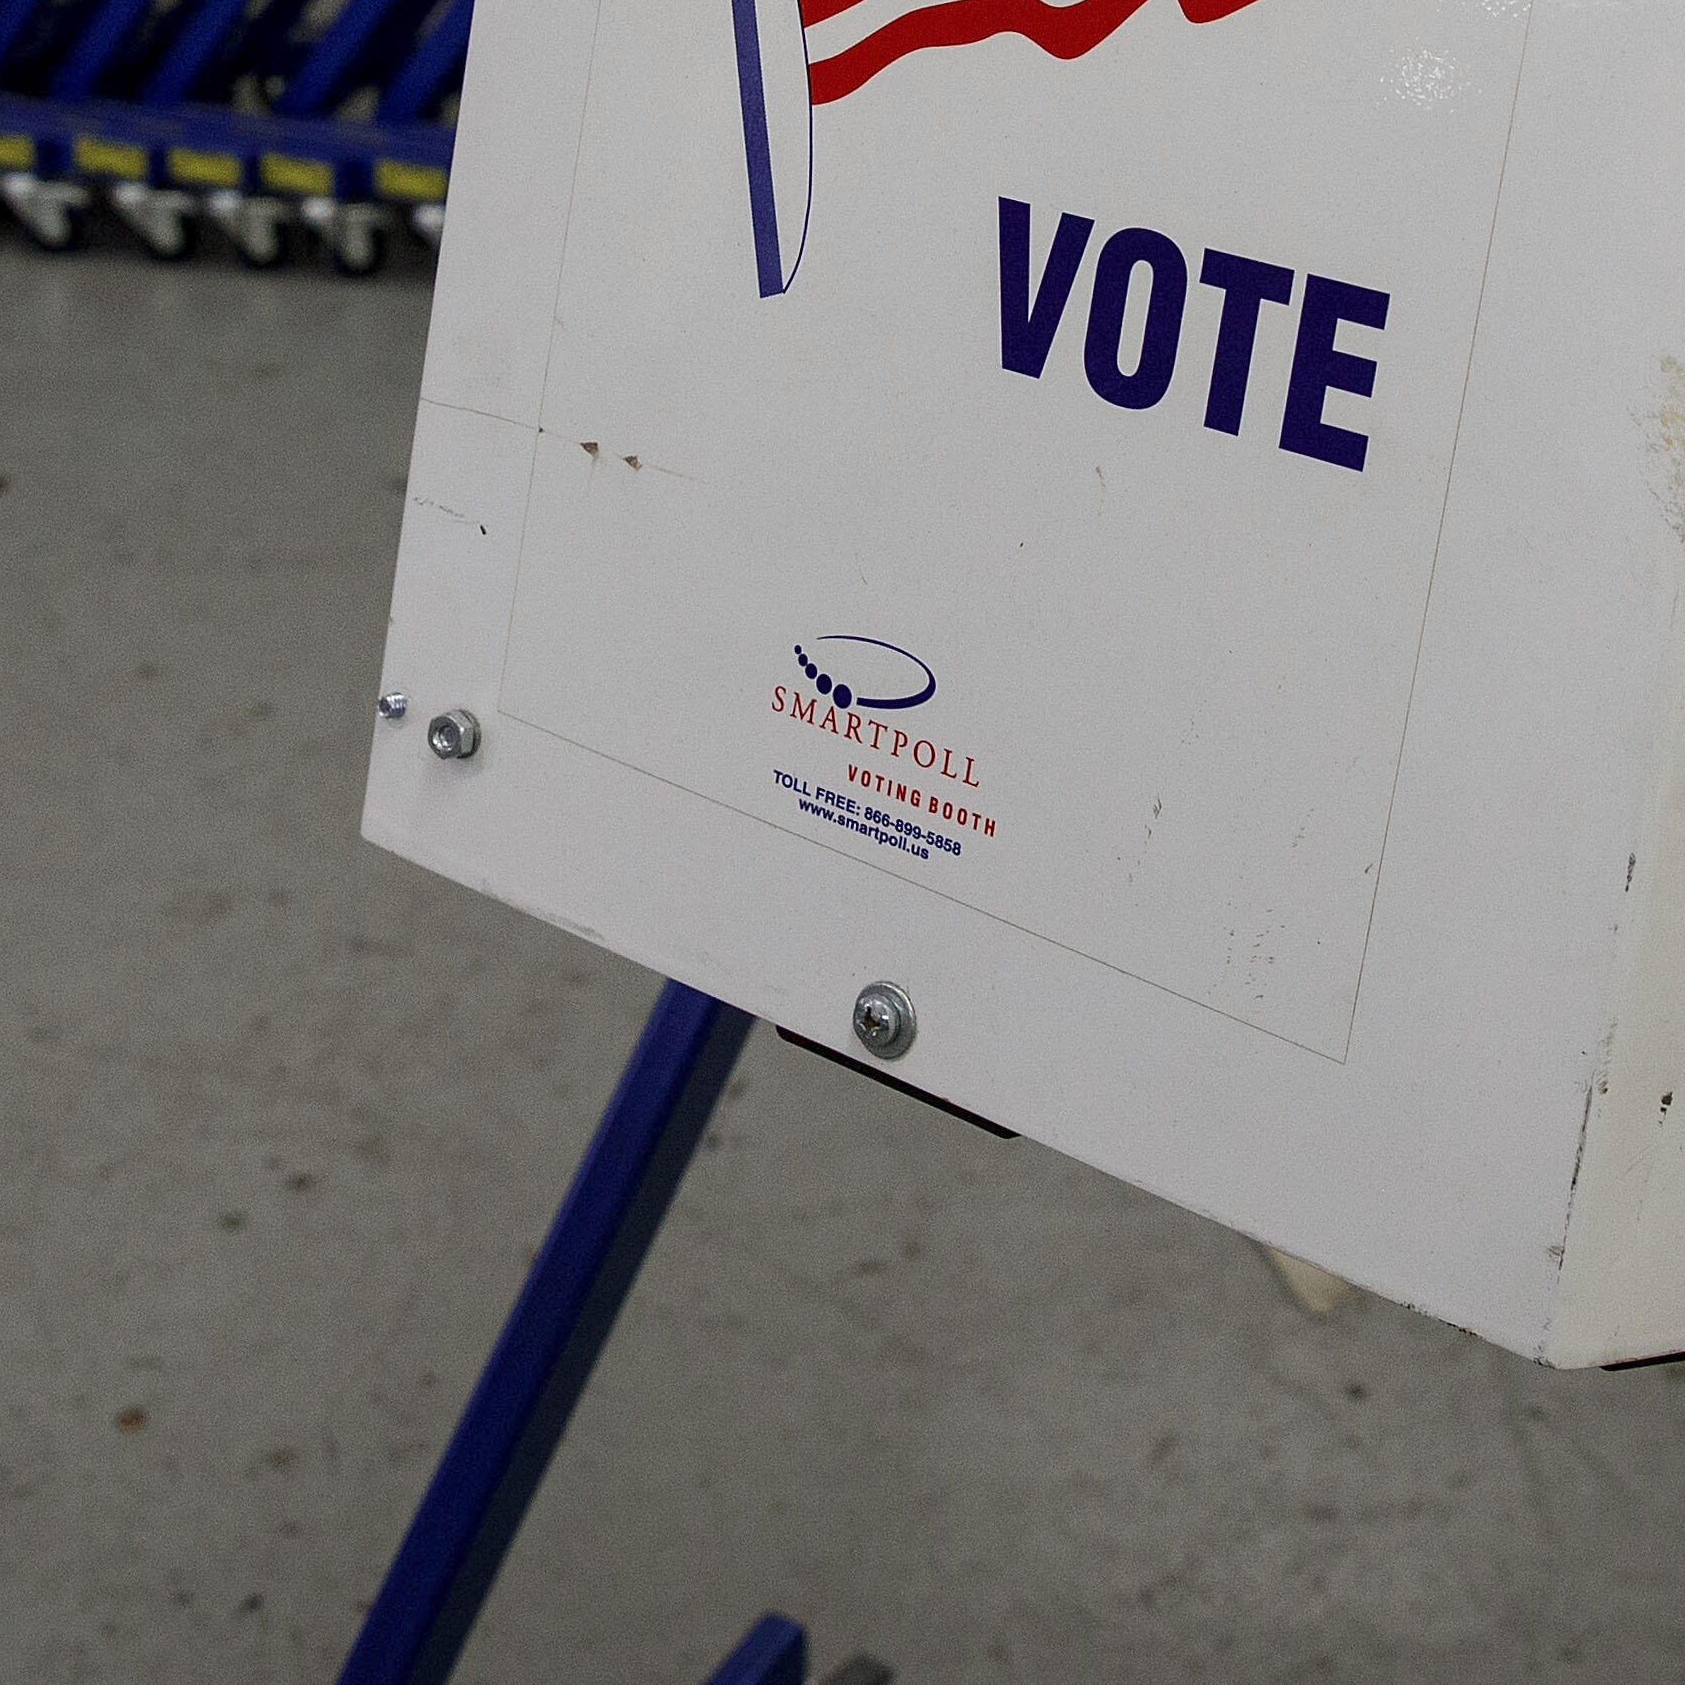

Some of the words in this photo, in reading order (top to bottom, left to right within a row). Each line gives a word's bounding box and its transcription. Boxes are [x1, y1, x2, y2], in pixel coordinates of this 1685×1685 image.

[998, 196, 1390, 472] VOTE
[771, 685, 980, 788] SMARTPOLL
[773, 768, 812, 797] TOLL
[815, 786, 861, 816] FREE:
[864, 806, 962, 857] 866-899-5858
[798, 798, 930, 860] www.smartpoll.us
[847, 763, 921, 808] VOTING
[928, 796, 996, 838] BOOTH
